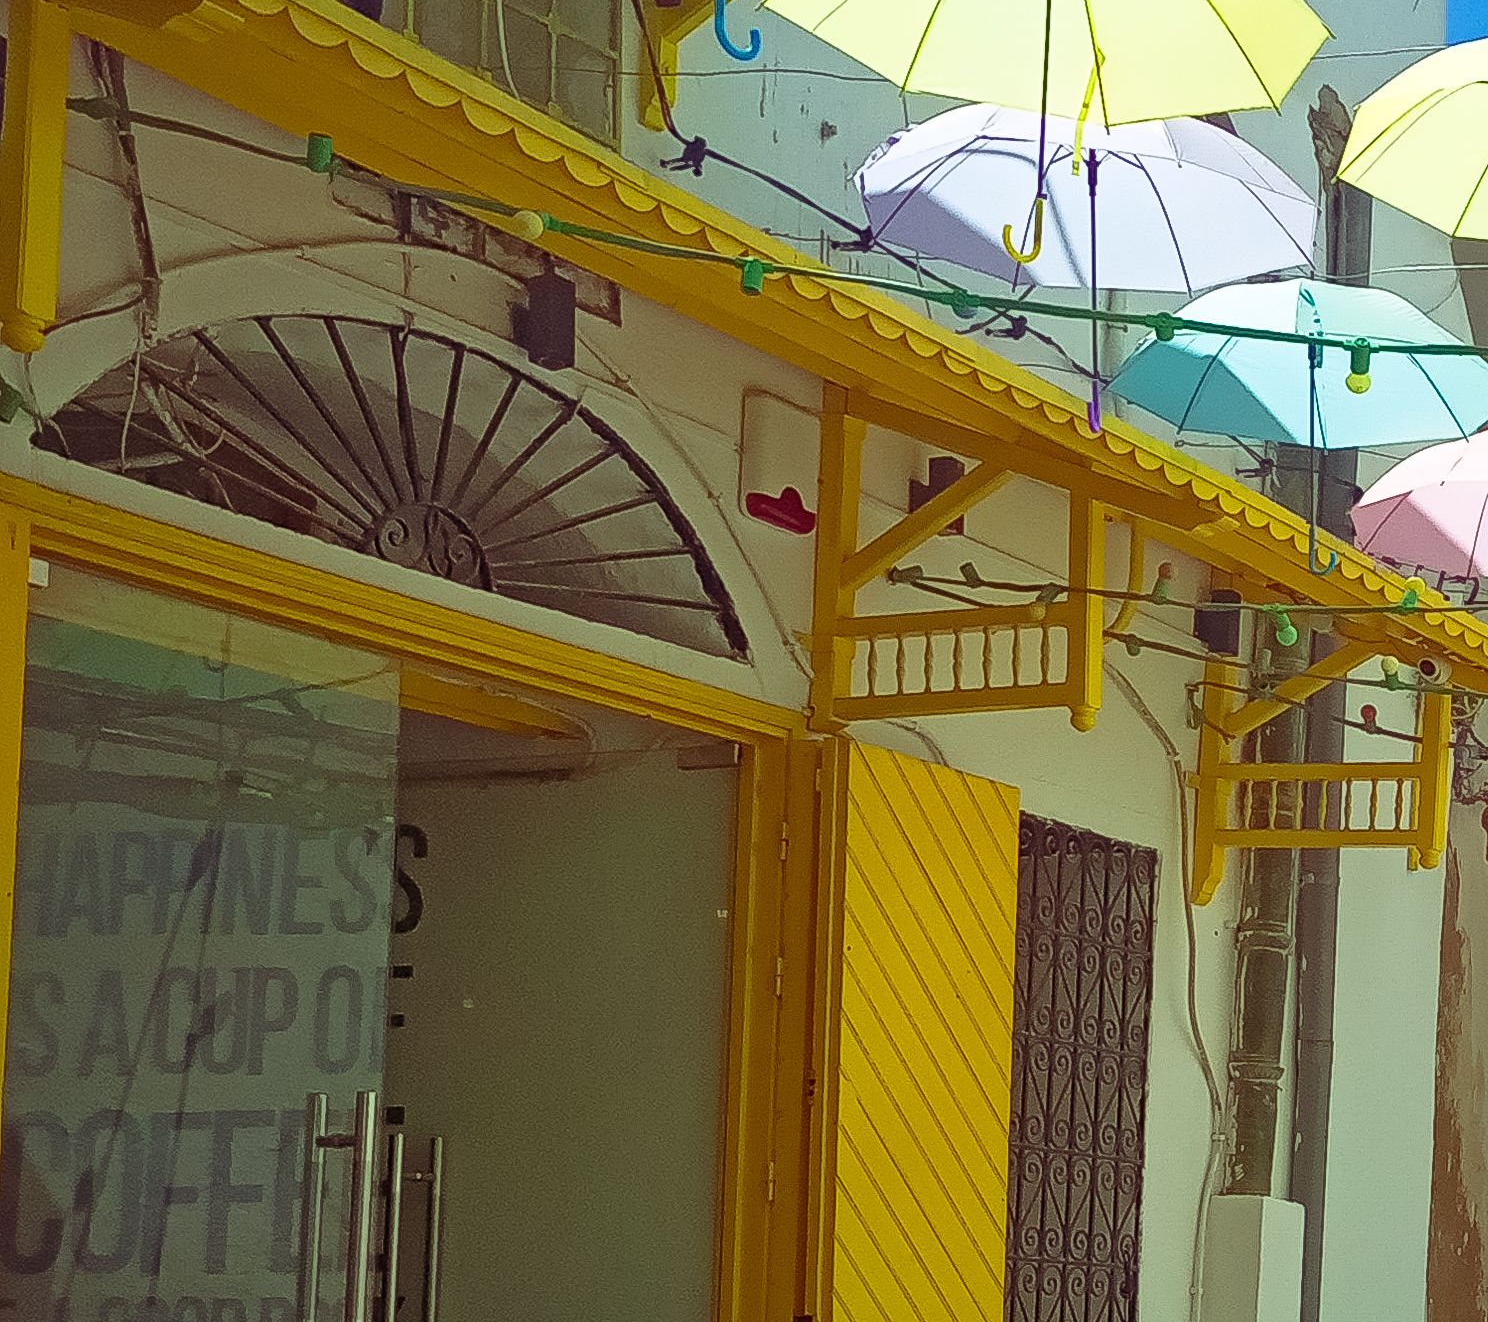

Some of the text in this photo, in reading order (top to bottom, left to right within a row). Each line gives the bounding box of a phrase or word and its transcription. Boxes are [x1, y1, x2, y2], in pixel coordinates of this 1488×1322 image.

[12, 965, 413, 1077] S A CUP OF
